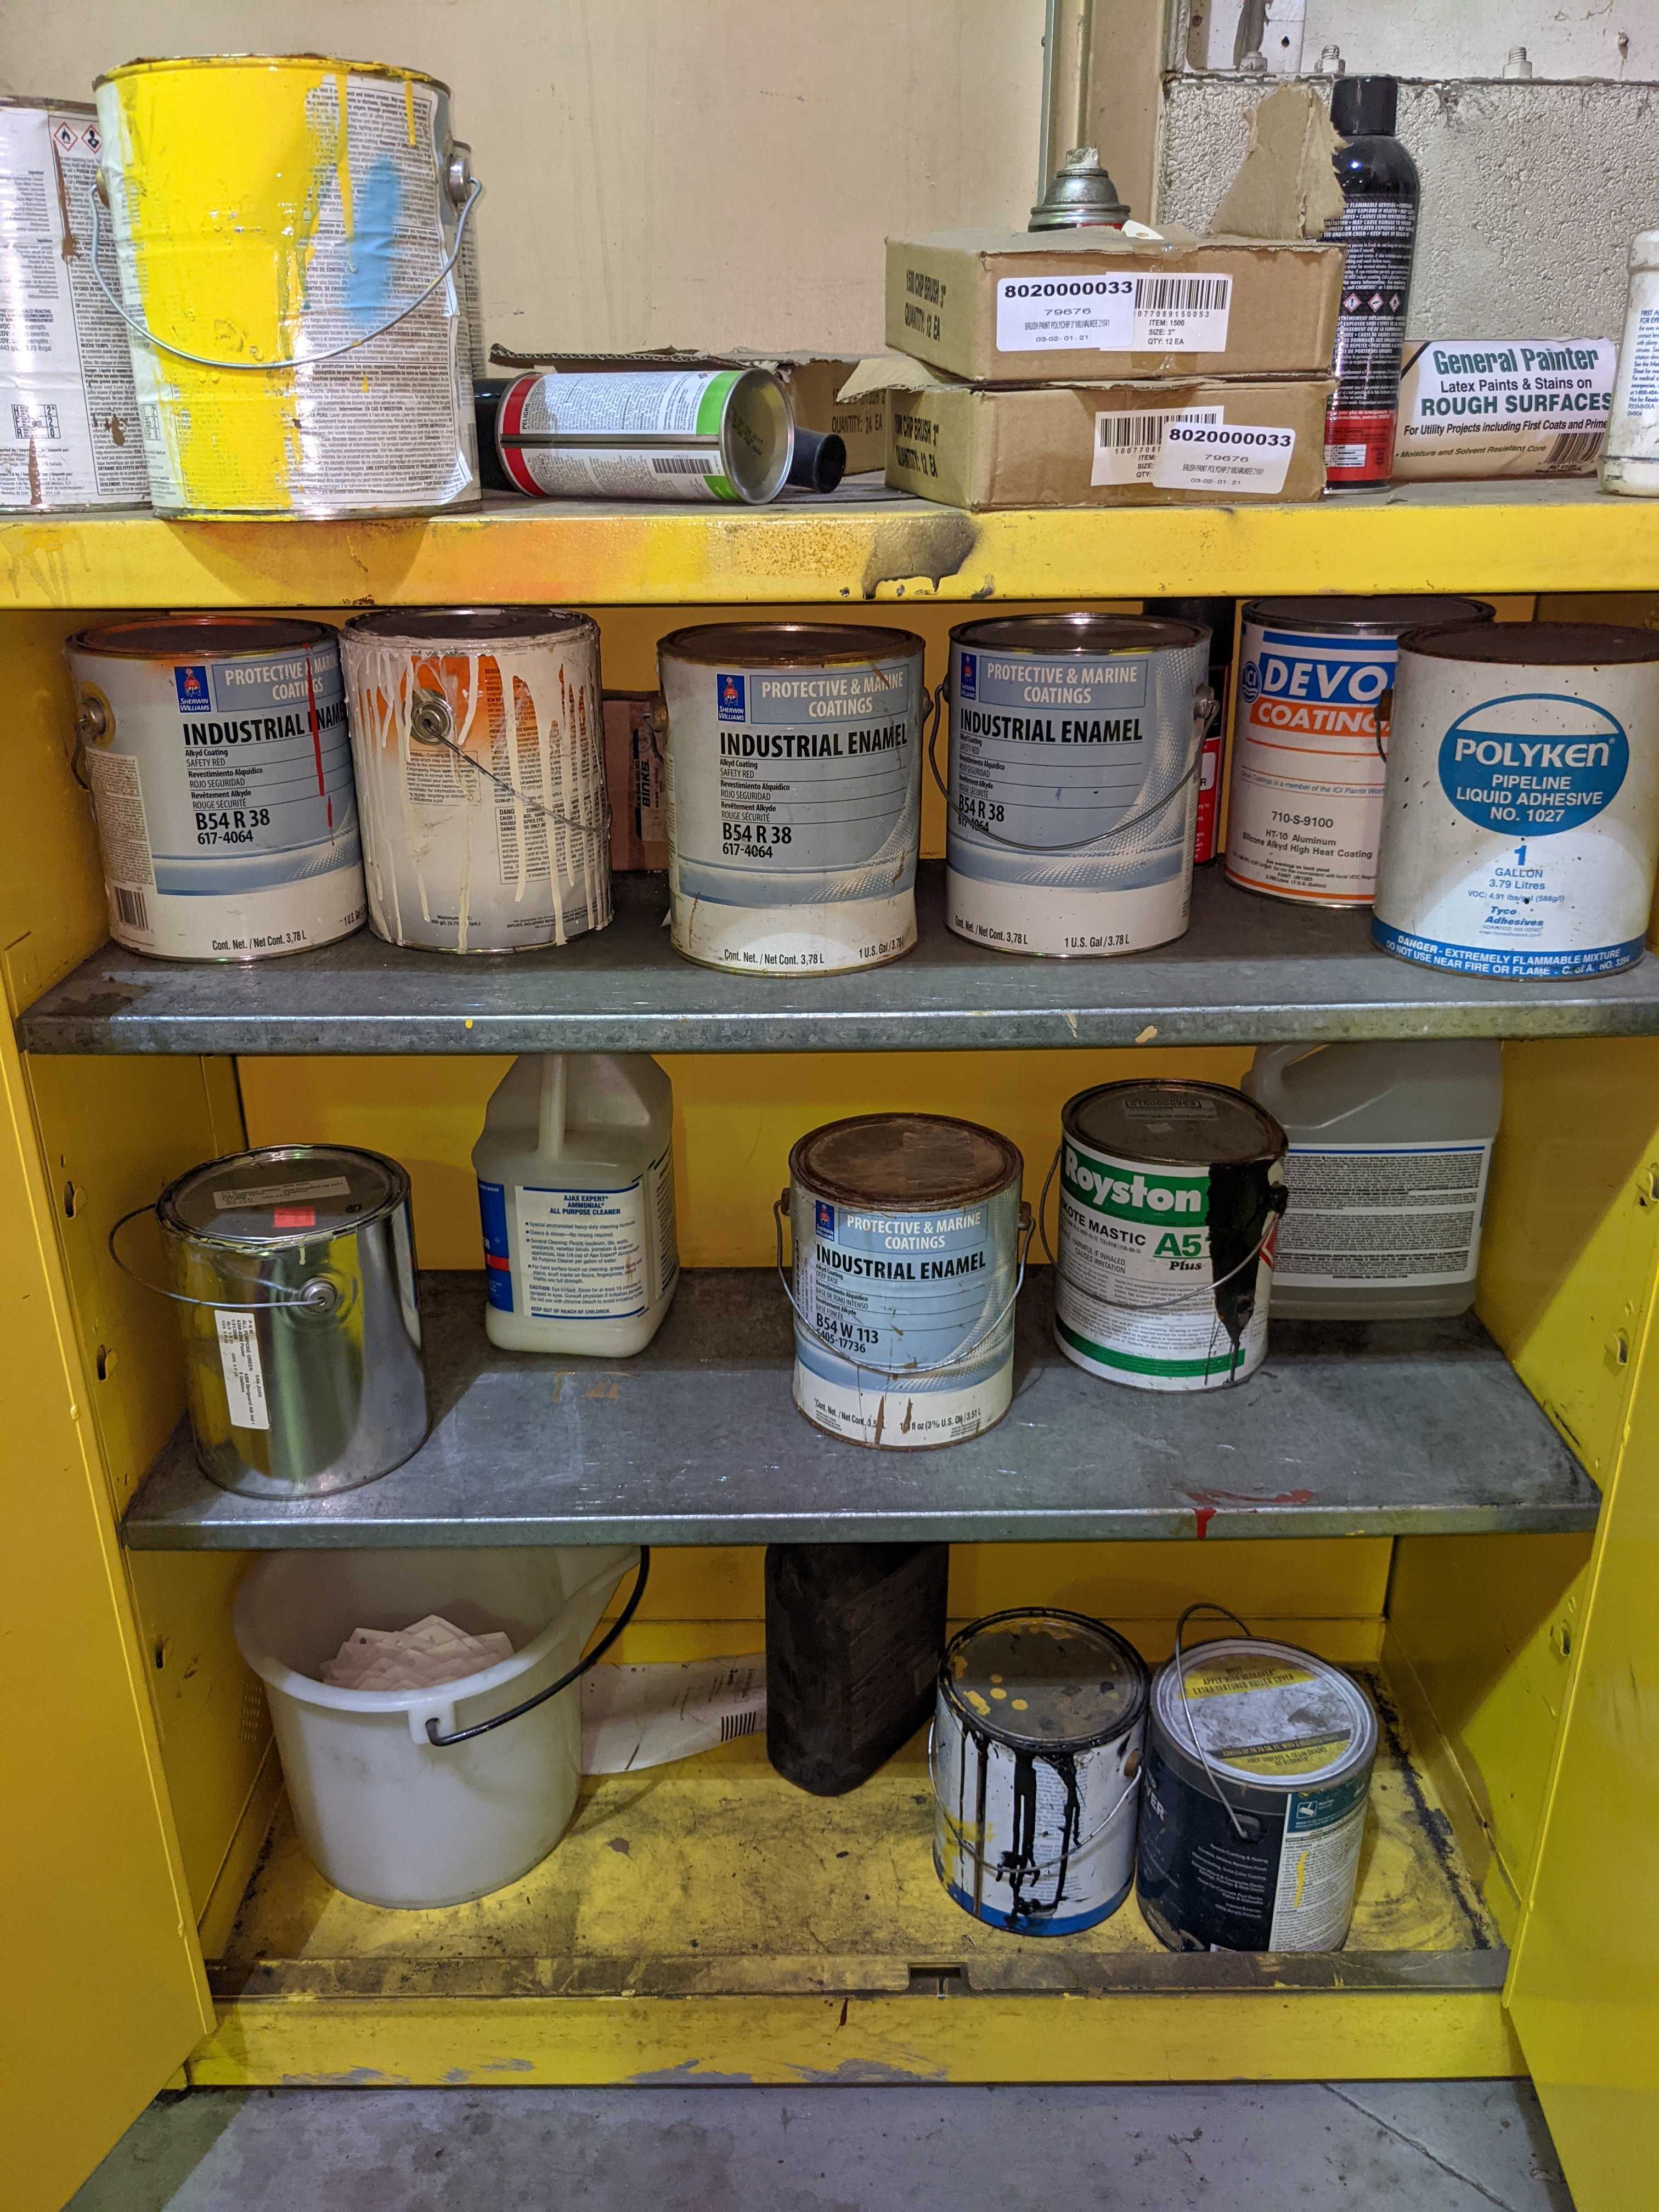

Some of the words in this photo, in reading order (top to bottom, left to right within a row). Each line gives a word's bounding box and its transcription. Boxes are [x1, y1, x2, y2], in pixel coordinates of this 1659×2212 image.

[1005, 281, 1132, 298] 8020000033
[1051, 320, 1070, 329] POLYCHIP
[1432, 349, 1517, 375] General
[1520, 347, 1599, 371] Painter
[1441, 380, 1474, 393] Latex
[1479, 379, 1518, 392] Paints
[1523, 378, 1531, 390] &
[1536, 377, 1572, 390] Stains
[1577, 378, 1592, 388] on
[1421, 396, 1498, 416] ROUGH
[1505, 393, 1611, 414] SURFACES
[522, 403, 531, 430] PELIGRO
[832, 415, 862, 434] QUANTITY:
[866, 416, 872, 434] 24
[876, 414, 882, 431] EA
[1404, 425, 1418, 436] For
[1420, 424, 1444, 436] Utility
[1447, 421, 1480, 436] Projects
[1482, 421, 1520, 433] including
[1523, 420, 1542, 431] First
[1543, 420, 1566, 430] Coats
[1568, 419, 1583, 429] and
[1169, 429, 1291, 447] 8020000033
[1205, 454, 1249, 462] 79676
[1400, 450, 1436, 458] Moisture
[1488, 445, 1525, 453] Resistant
[225, 662, 303, 686] PROTECTIVE
[988, 663, 1063, 684] PROTECTIVE
[1066, 668, 1078, 684] &
[1081, 666, 1137, 684] MARINE
[1263, 658, 1395, 703] DEVO
[762, 679, 848, 698] PROTECTIVE
[850, 680, 861, 695] &
[864, 672, 903, 693] MARINE
[1024, 686, 1091, 703] COATINGS
[808, 697, 872, 718] COATINGS
[183, 713, 304, 746] INDUSTRIAL
[961, 708, 1056, 743] INDUSTRIAL
[1061, 719, 1142, 743] ENAMEL
[720, 732, 843, 758] INDUSTRIAL
[848, 723, 907, 755] ENAMEL
[185, 749, 202, 758] Alkyd
[204, 749, 228, 759] Coating
[187, 759, 211, 767] SAFETY
[188, 770, 234, 778] Revestimiento
[235, 768, 263, 776] Alquídico
[190, 780, 206, 788] ROJO
[208, 778, 245, 787] SEGURIDAD
[1492, 775, 1571, 790] PIPELINE
[231, 789, 252, 798] Alkyde
[1457, 786, 1512, 805] LIQUID
[1516, 792, 1602, 806] ADHESIVE
[216, 798, 247, 808] SÉCURITÉ
[195, 812, 230, 830] B54
[234, 811, 246, 828] R
[249, 809, 270, 827] 38
[1272, 811, 1334, 828] 710-S-9100
[1491, 808, 1520, 821] NO.
[1526, 809, 1565, 822] 1027
[198, 830, 253, 844] 617-4064
[723, 822, 752, 842] B54
[757, 825, 766, 843] R
[771, 826, 792, 844] 38
[1266, 829, 1288, 840] HT-10
[1292, 834, 1336, 846] Aluminum
[723, 842, 773, 858] 617-4064
[1242, 832, 1265, 845] Silicone
[1266, 839, 1288, 851] Alkyd
[1290, 845, 1310, 855] High
[1313, 847, 1334, 856] Heat
[1338, 850, 1372, 860] Coating
[1514, 845, 1527, 866] 1
[1495, 867, 1543, 878] GALLON
[1489, 879, 1511, 888] 3.79
[1515, 881, 1545, 890] Litres
[1491, 906, 1517, 915] Tyco
[1485, 916, 1544, 926] Adhesives
[724, 949, 741, 961] Cont.
[743, 952, 758, 963] Net.
[765, 953, 777, 965] Net
[780, 954, 799, 965] Cont.
[800, 953, 818, 966] 3,78
[820, 953, 825, 964] L
[1398, 935, 1437, 953] DANGER
[1445, 948, 1510, 965] EXTREMELY
[1513, 955, 1580, 965] FLAMMABLE
[1583, 949, 1621, 963] MIXTURE
[1396, 944, 1412, 957] NOT
[1413, 950, 1431, 962] USE
[1434, 956, 1462, 969] NEAR
[1465, 961, 1489, 972] FIRE
[1493, 964, 1509, 974] OR
[1513, 966, 1550, 975] FLAME
[1065, 1145, 1201, 1212] Royston
[847, 1215, 921, 1235] PROTECTIVE
[923, 1221, 933, 1234] &
[936, 1211, 981, 1233] MARINE
[1088, 1218, 1146, 1246] MASTIC
[884, 1235, 946, 1250] COATINGS
[816, 1244, 916, 1280] INDUSTRIAL
[921, 1251, 986, 1279] ENAMEL
[1169, 1260, 1202, 1271] Plus
[833, 1295, 845, 1304] TONO
[846, 1299, 868, 1310] INTENSO
[817, 1312, 838, 1334] B54
[840, 1322, 853, 1338] W
[857, 1328, 878, 1344] 113
